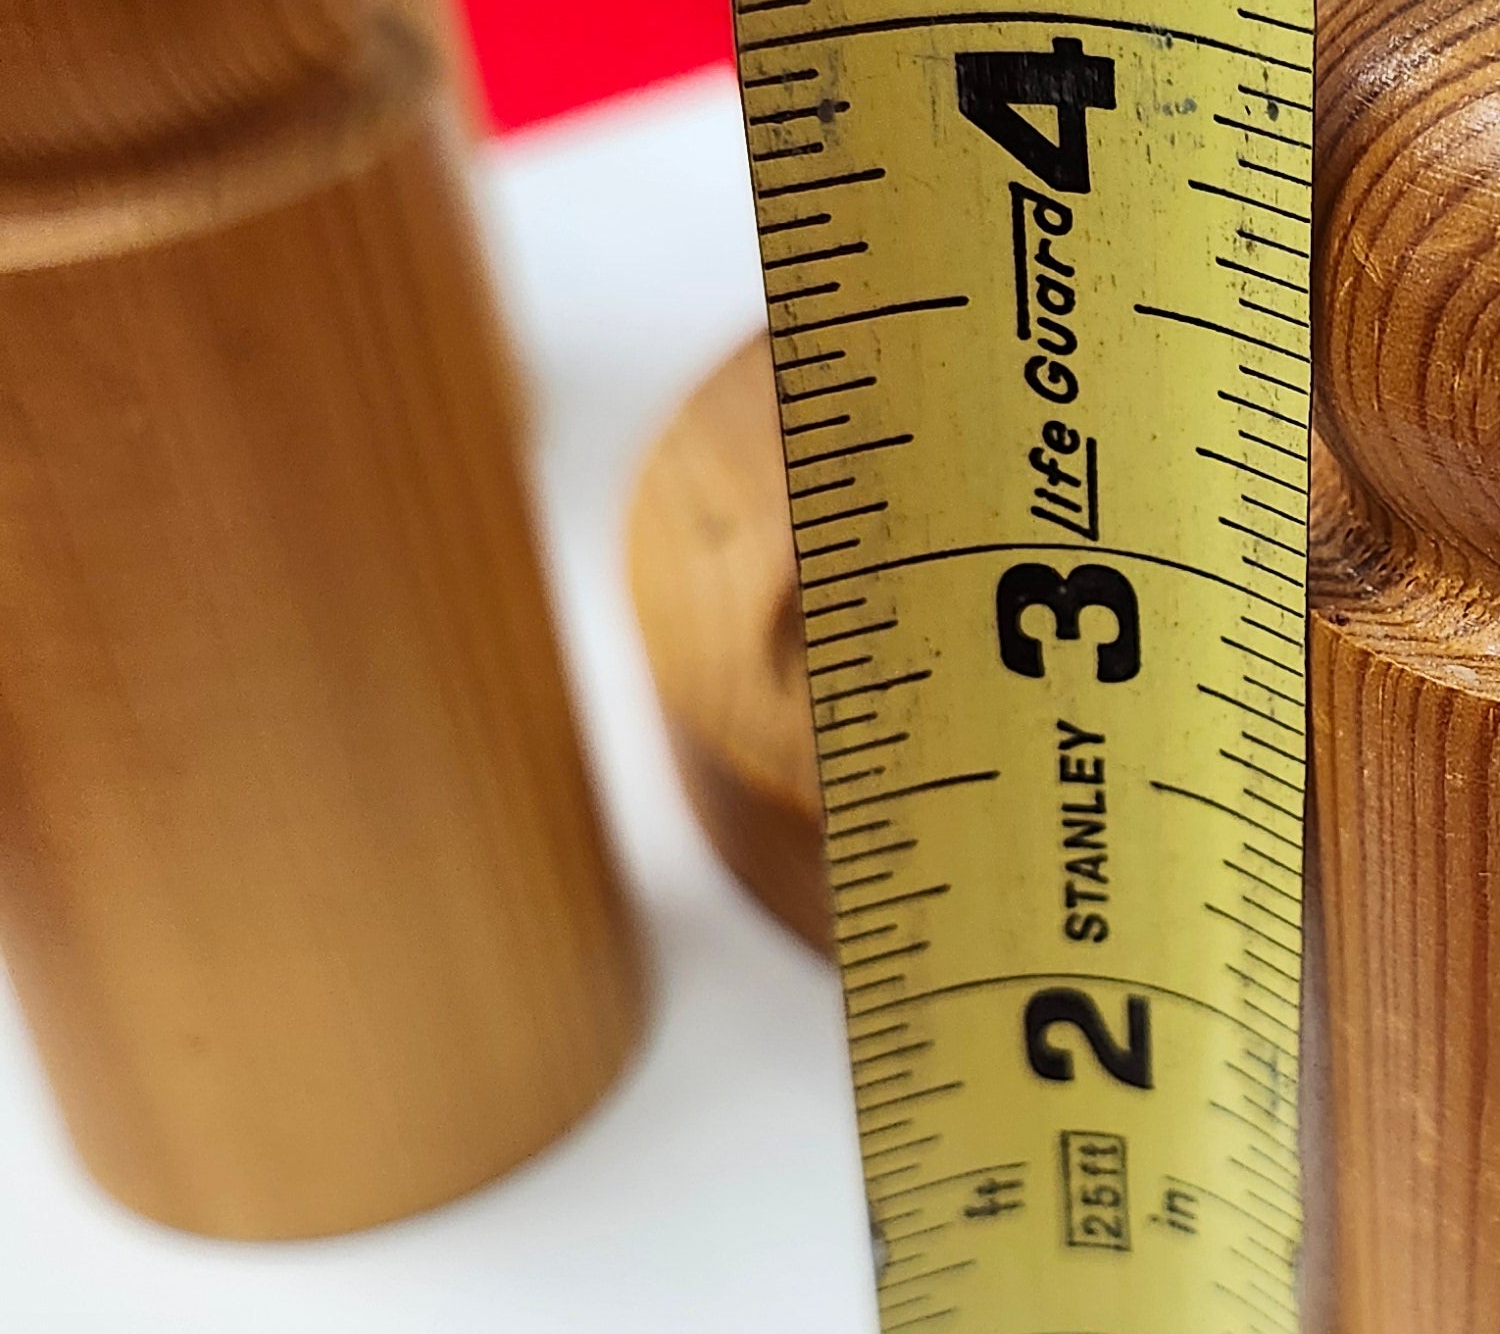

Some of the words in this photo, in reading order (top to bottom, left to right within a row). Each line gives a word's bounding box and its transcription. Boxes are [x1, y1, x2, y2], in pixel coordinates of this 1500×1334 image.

[955, 37, 1116, 194] 4
[1010, 181, 1081, 405] Guard
[996, 562, 1141, 684] 3
[1056, 719, 1109, 944] STANLEY
[1023, 986, 1155, 1091] 2
[1147, 1186, 1199, 1235] in
